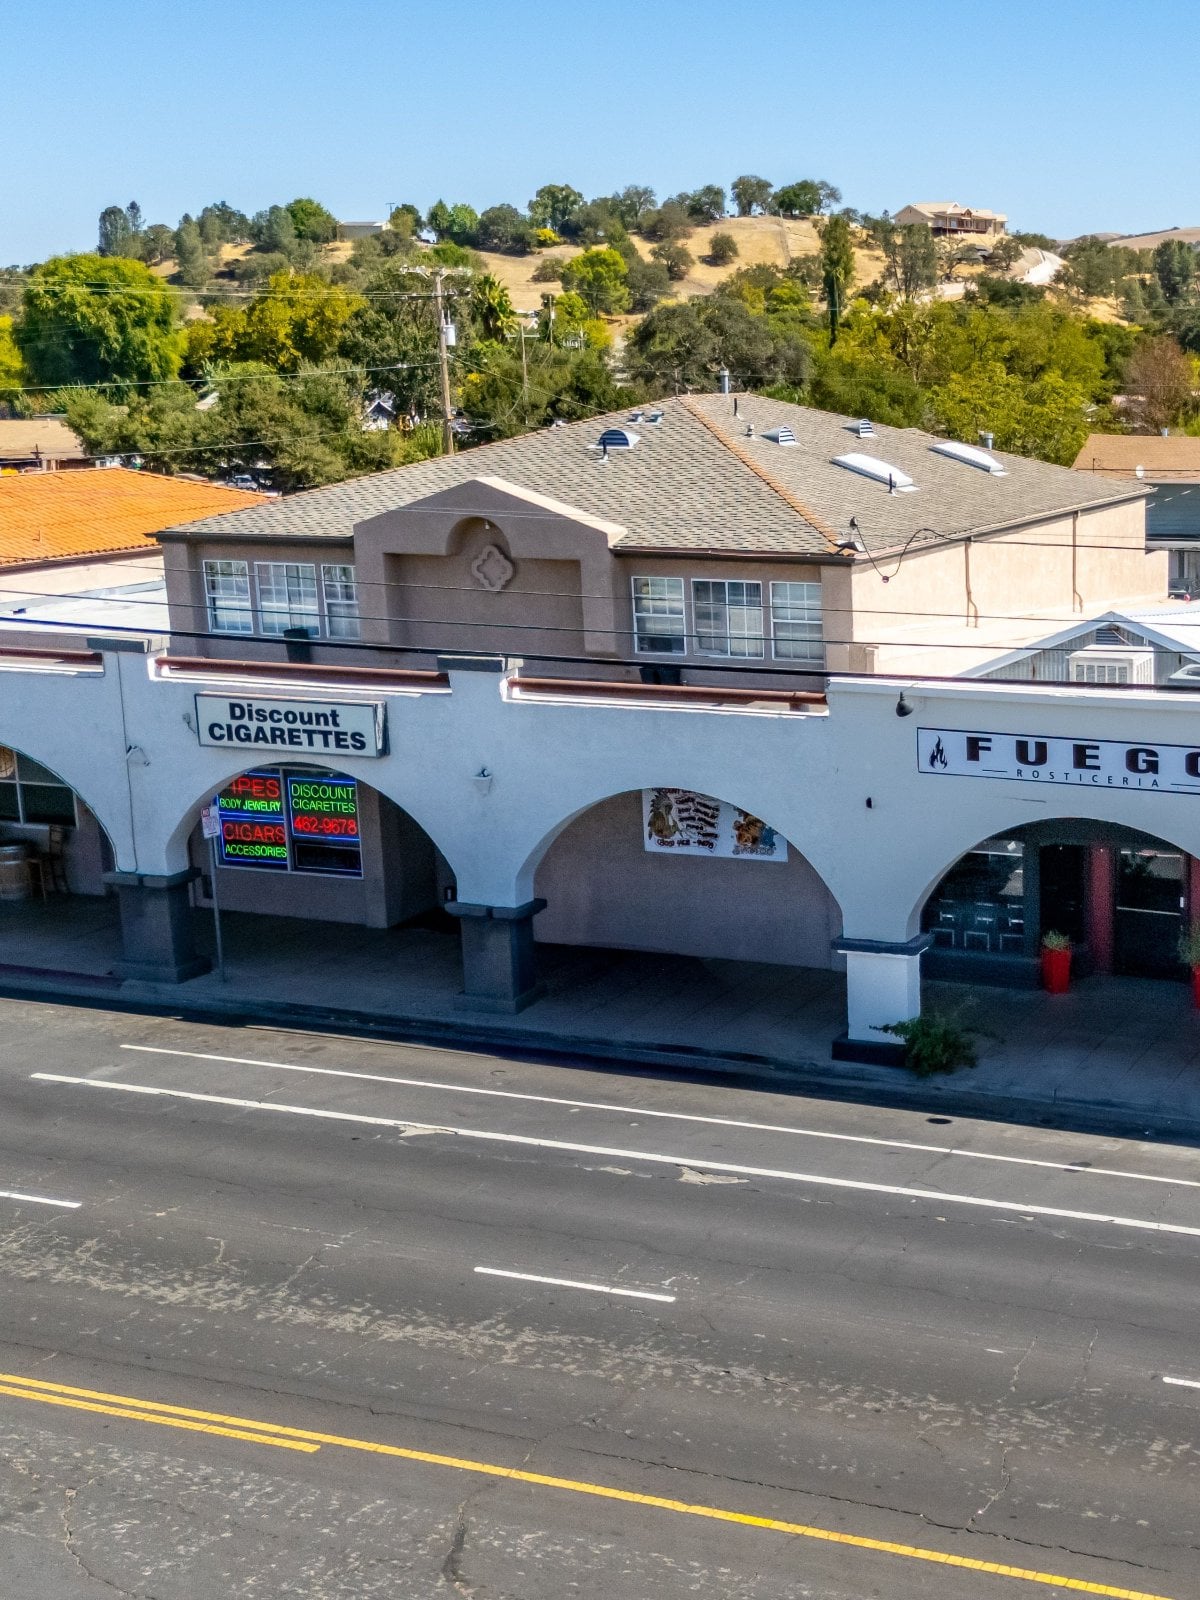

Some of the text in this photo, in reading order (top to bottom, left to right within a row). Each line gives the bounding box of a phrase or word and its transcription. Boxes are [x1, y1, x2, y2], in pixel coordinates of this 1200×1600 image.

[229, 703, 340, 728] Discount
[208, 722, 367, 751] CIGARETTES
[231, 776, 280, 798] IPES
[1016, 768, 1160, 788] ROSTICERIA
[291, 783, 355, 799] DISCOUNT
[219, 798, 281, 812] BODY JEWELRY
[292, 798, 356, 813] CIGARETTES
[223, 823, 286, 844] CIGARS
[293, 815, 357, 835] 462-9678
[225, 844, 287, 858] ACCESSORIES
